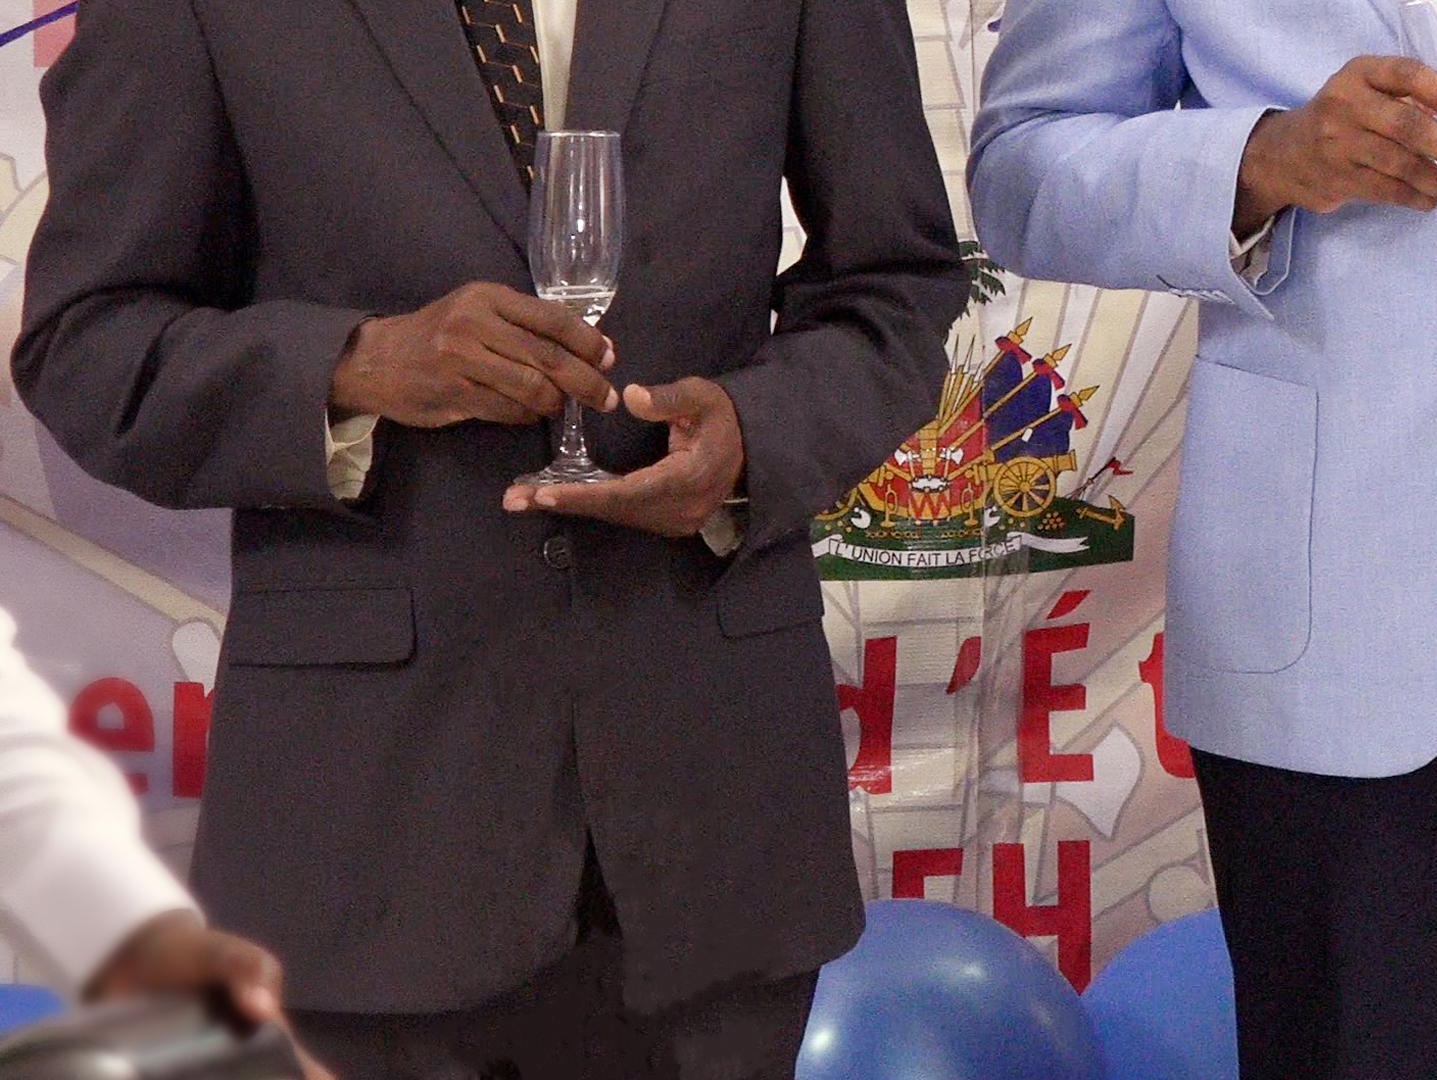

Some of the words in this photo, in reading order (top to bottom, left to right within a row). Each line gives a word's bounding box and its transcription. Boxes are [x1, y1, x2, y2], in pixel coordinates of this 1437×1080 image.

[851, 545, 902, 565] UNION
[906, 552, 940, 566] FAIT
[945, 552, 965, 565] LA
